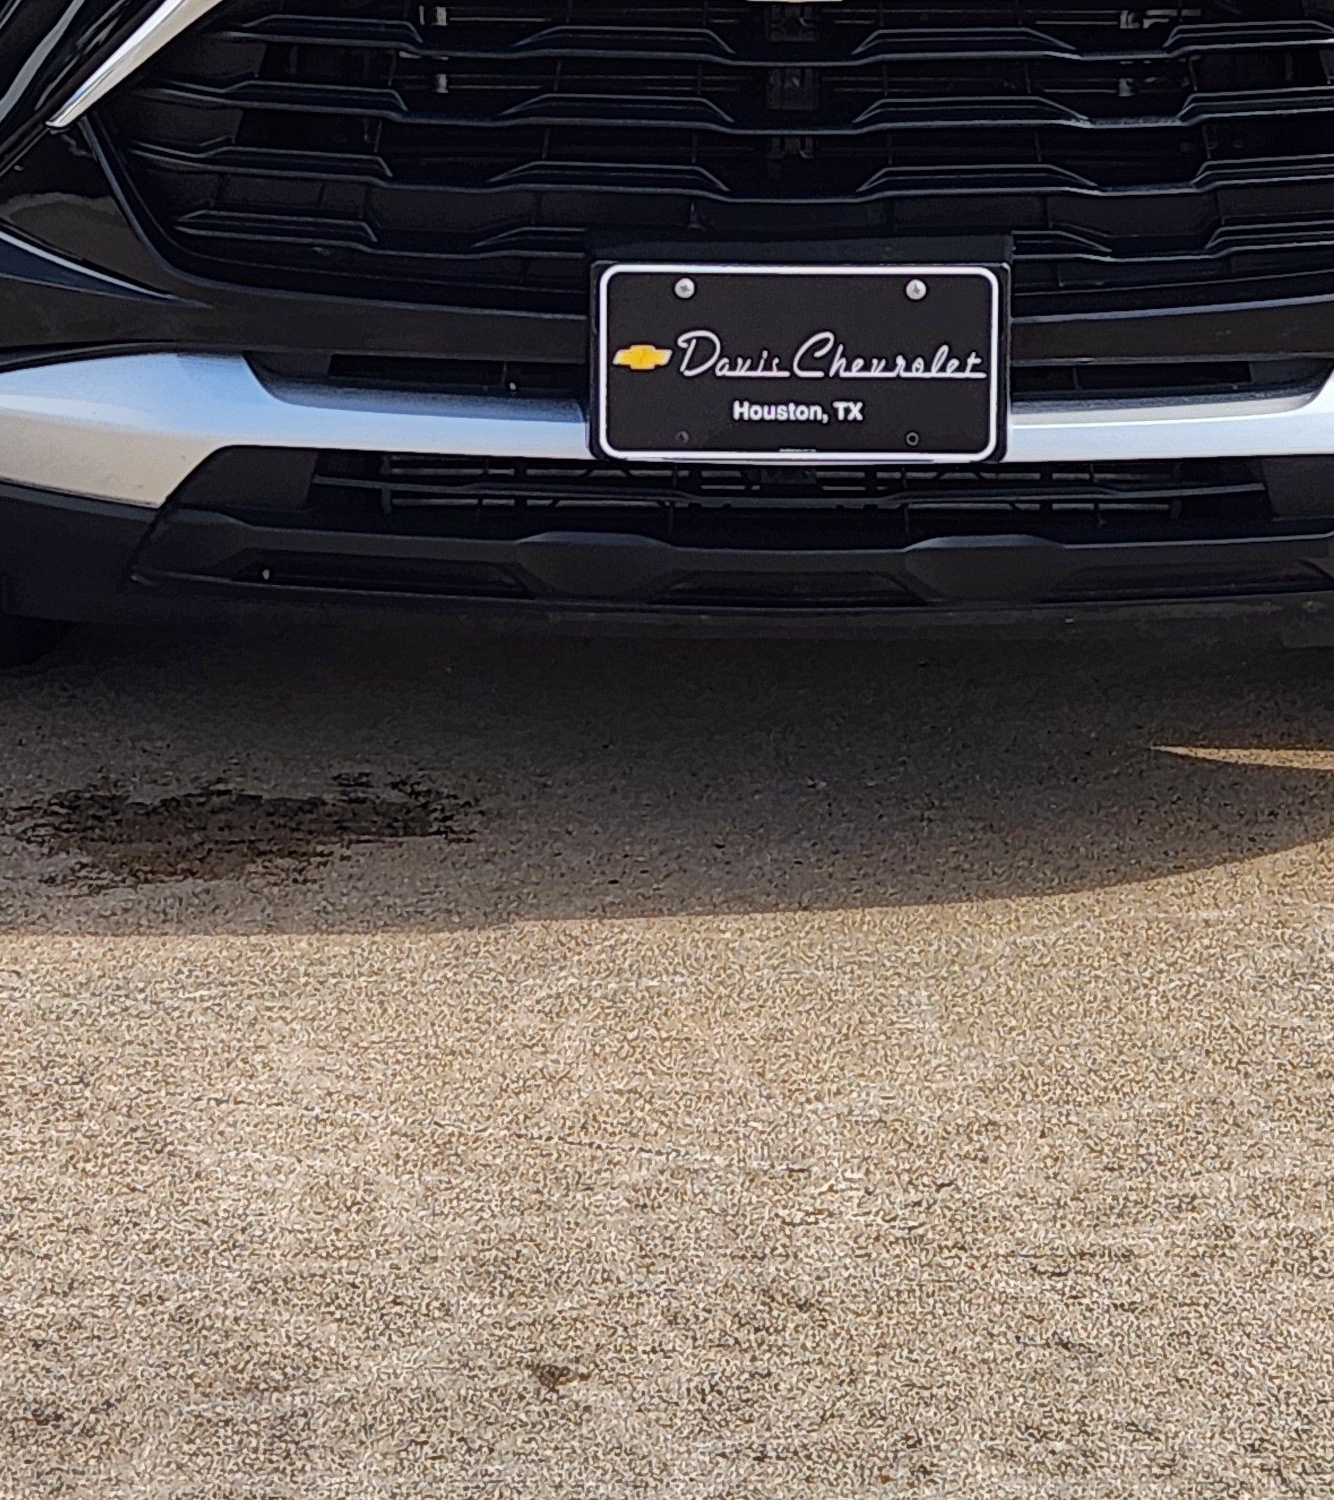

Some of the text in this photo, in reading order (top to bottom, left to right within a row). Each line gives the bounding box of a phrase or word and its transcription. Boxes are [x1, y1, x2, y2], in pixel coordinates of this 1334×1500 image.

[677, 330, 987, 379] Davis Chevrolet
[732, 400, 864, 424] Houston, TX
